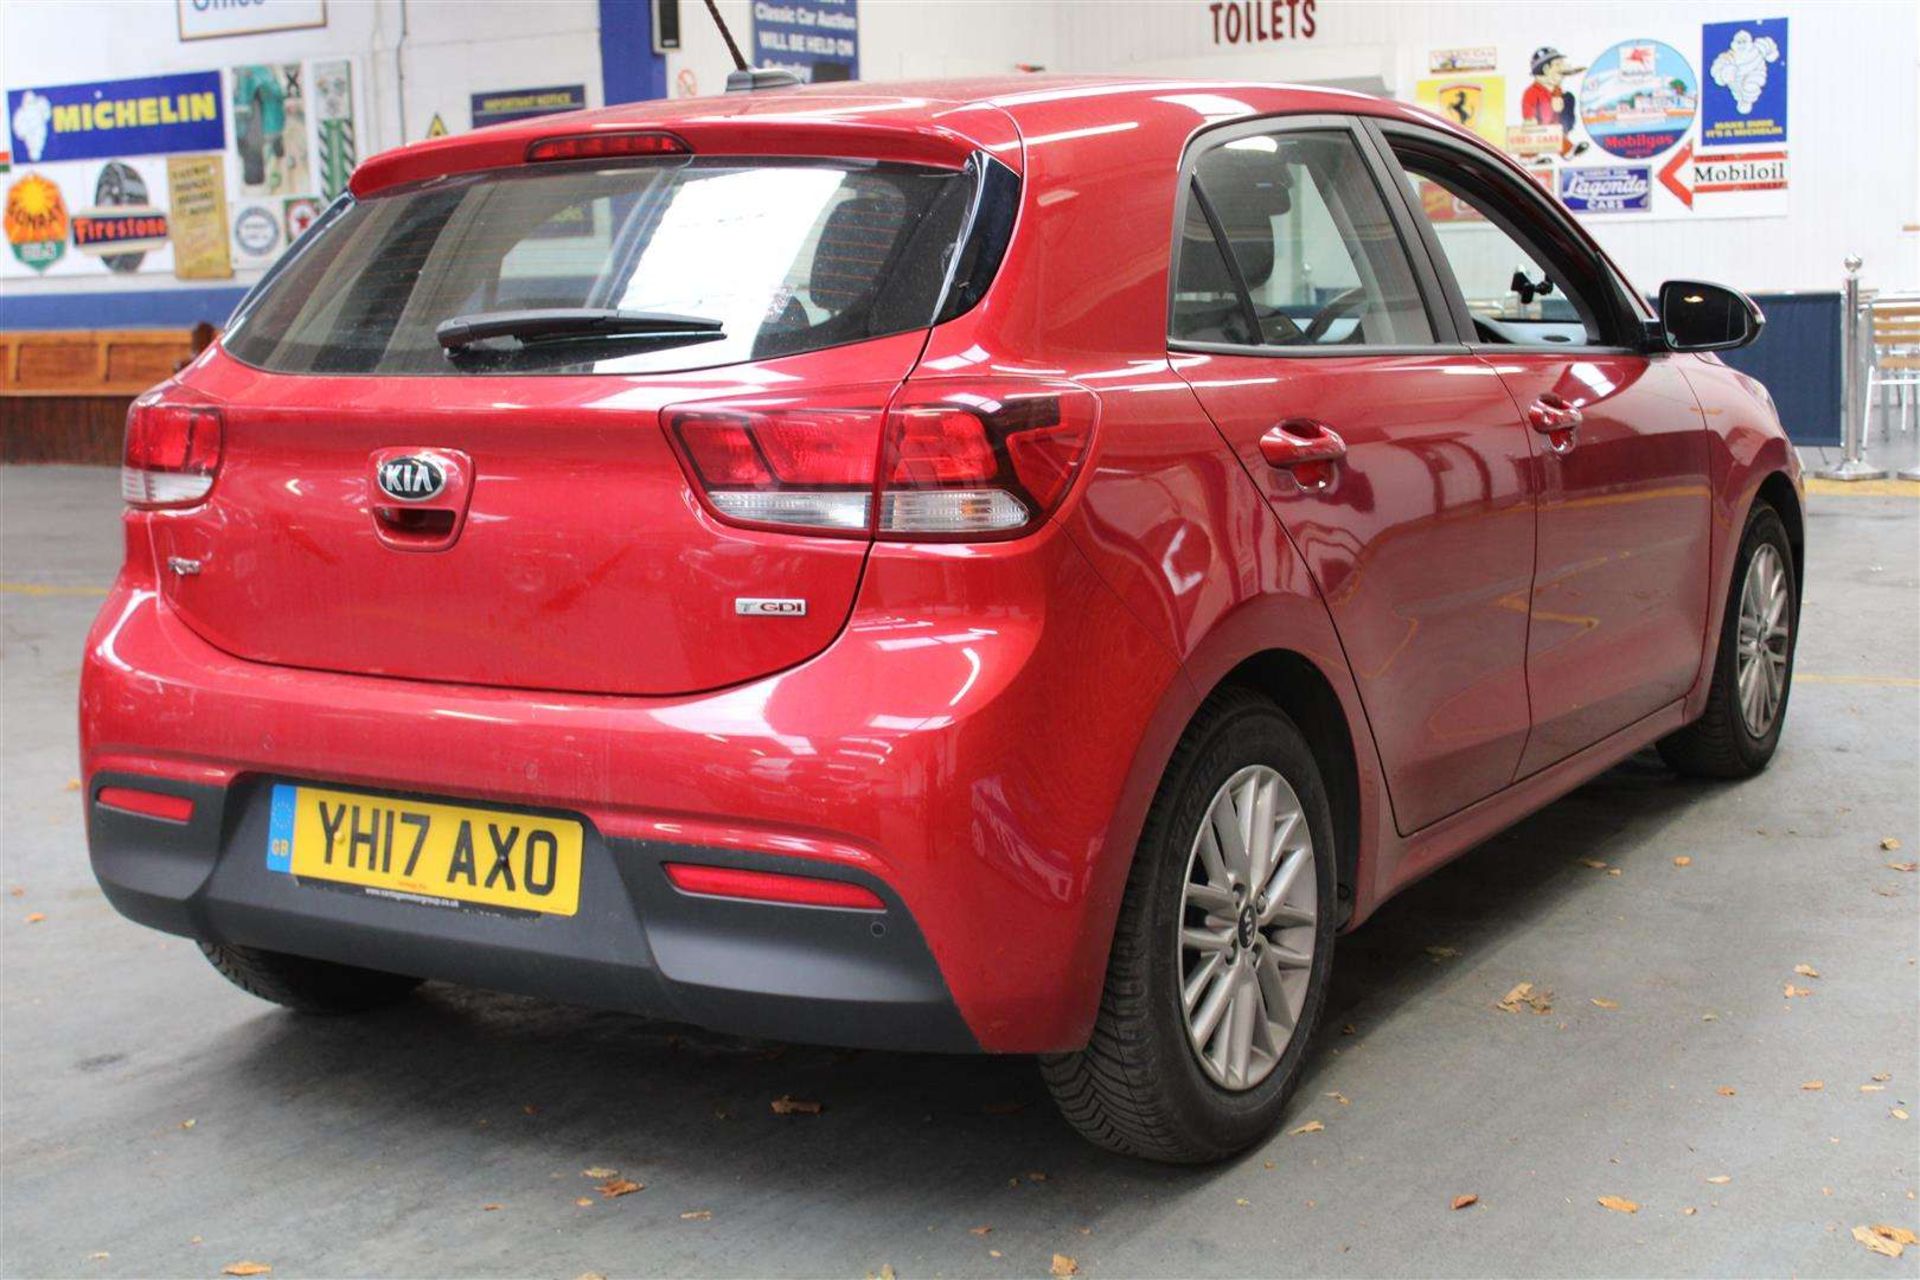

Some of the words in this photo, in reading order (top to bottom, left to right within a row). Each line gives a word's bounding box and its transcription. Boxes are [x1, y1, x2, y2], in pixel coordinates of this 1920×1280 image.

[755, 1, 796, 24] Classic
[796, 7, 817, 26] Car
[817, 9, 856, 30] Auction
[1209, 0, 1316, 44] TOILETS
[759, 31, 788, 50] WILL
[788, 33, 805, 52] BE
[805, 35, 836, 55] HELD
[836, 39, 855, 57] ON
[53, 91, 217, 134] MICHELIN
[1604, 134, 1675, 152] Mobilgas
[1567, 173, 1648, 197] Lagonda
[1694, 162, 1784, 182] Mobiloil
[1587, 198, 1624, 210] CARS
[73, 215, 167, 246] Firestone
[385, 464, 433, 492] KIA
[760, 602, 802, 612] GDI
[271, 838, 289, 857] GB
[318, 801, 431, 877] YH17
[446, 819, 559, 897] AXO
